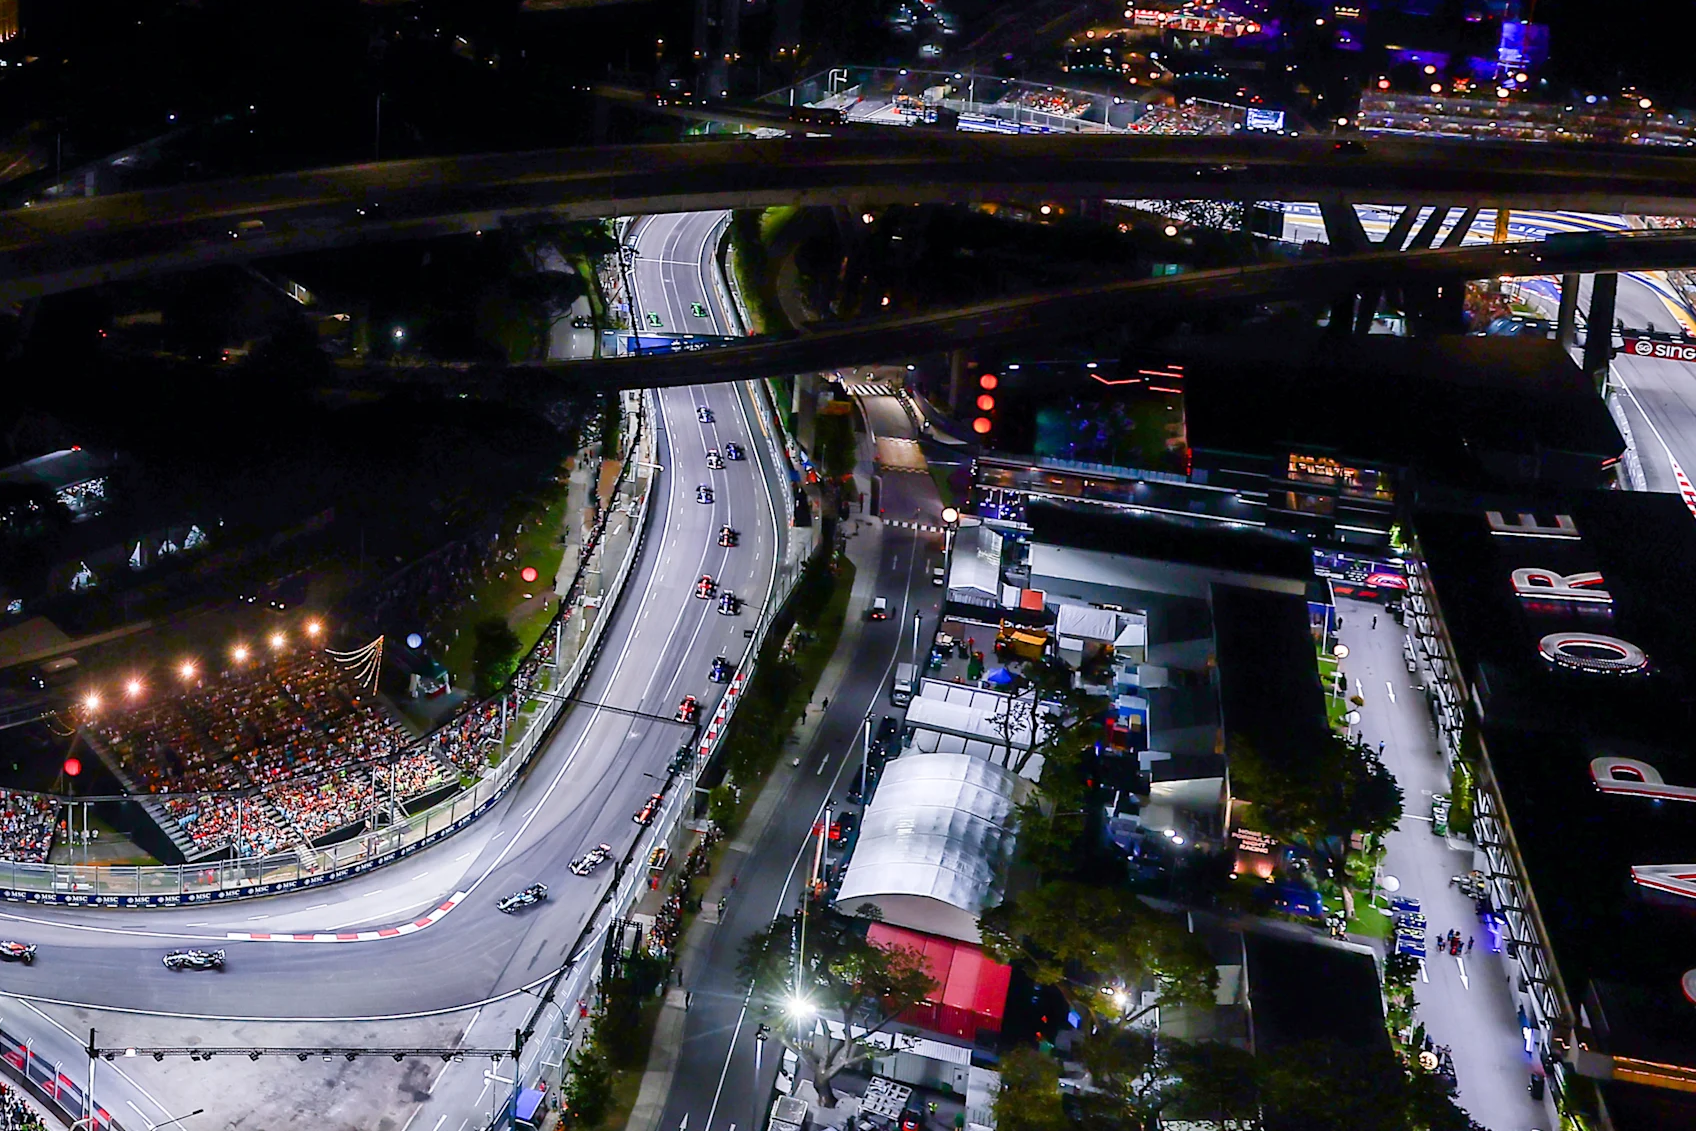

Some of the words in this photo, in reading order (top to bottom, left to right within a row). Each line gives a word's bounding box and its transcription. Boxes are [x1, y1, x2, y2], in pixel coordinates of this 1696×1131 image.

[336, 869, 349, 878] MSC
[310, 875, 325, 884] MSC
[282, 881, 297, 889] MSC
[11, 890, 26, 898] MSC
[225, 889, 241, 897] MSC
[254, 886, 269, 894] MSC
[41, 893, 57, 901] MSC
[165, 895, 181, 903] MSC
[195, 893, 212, 901] MSC
